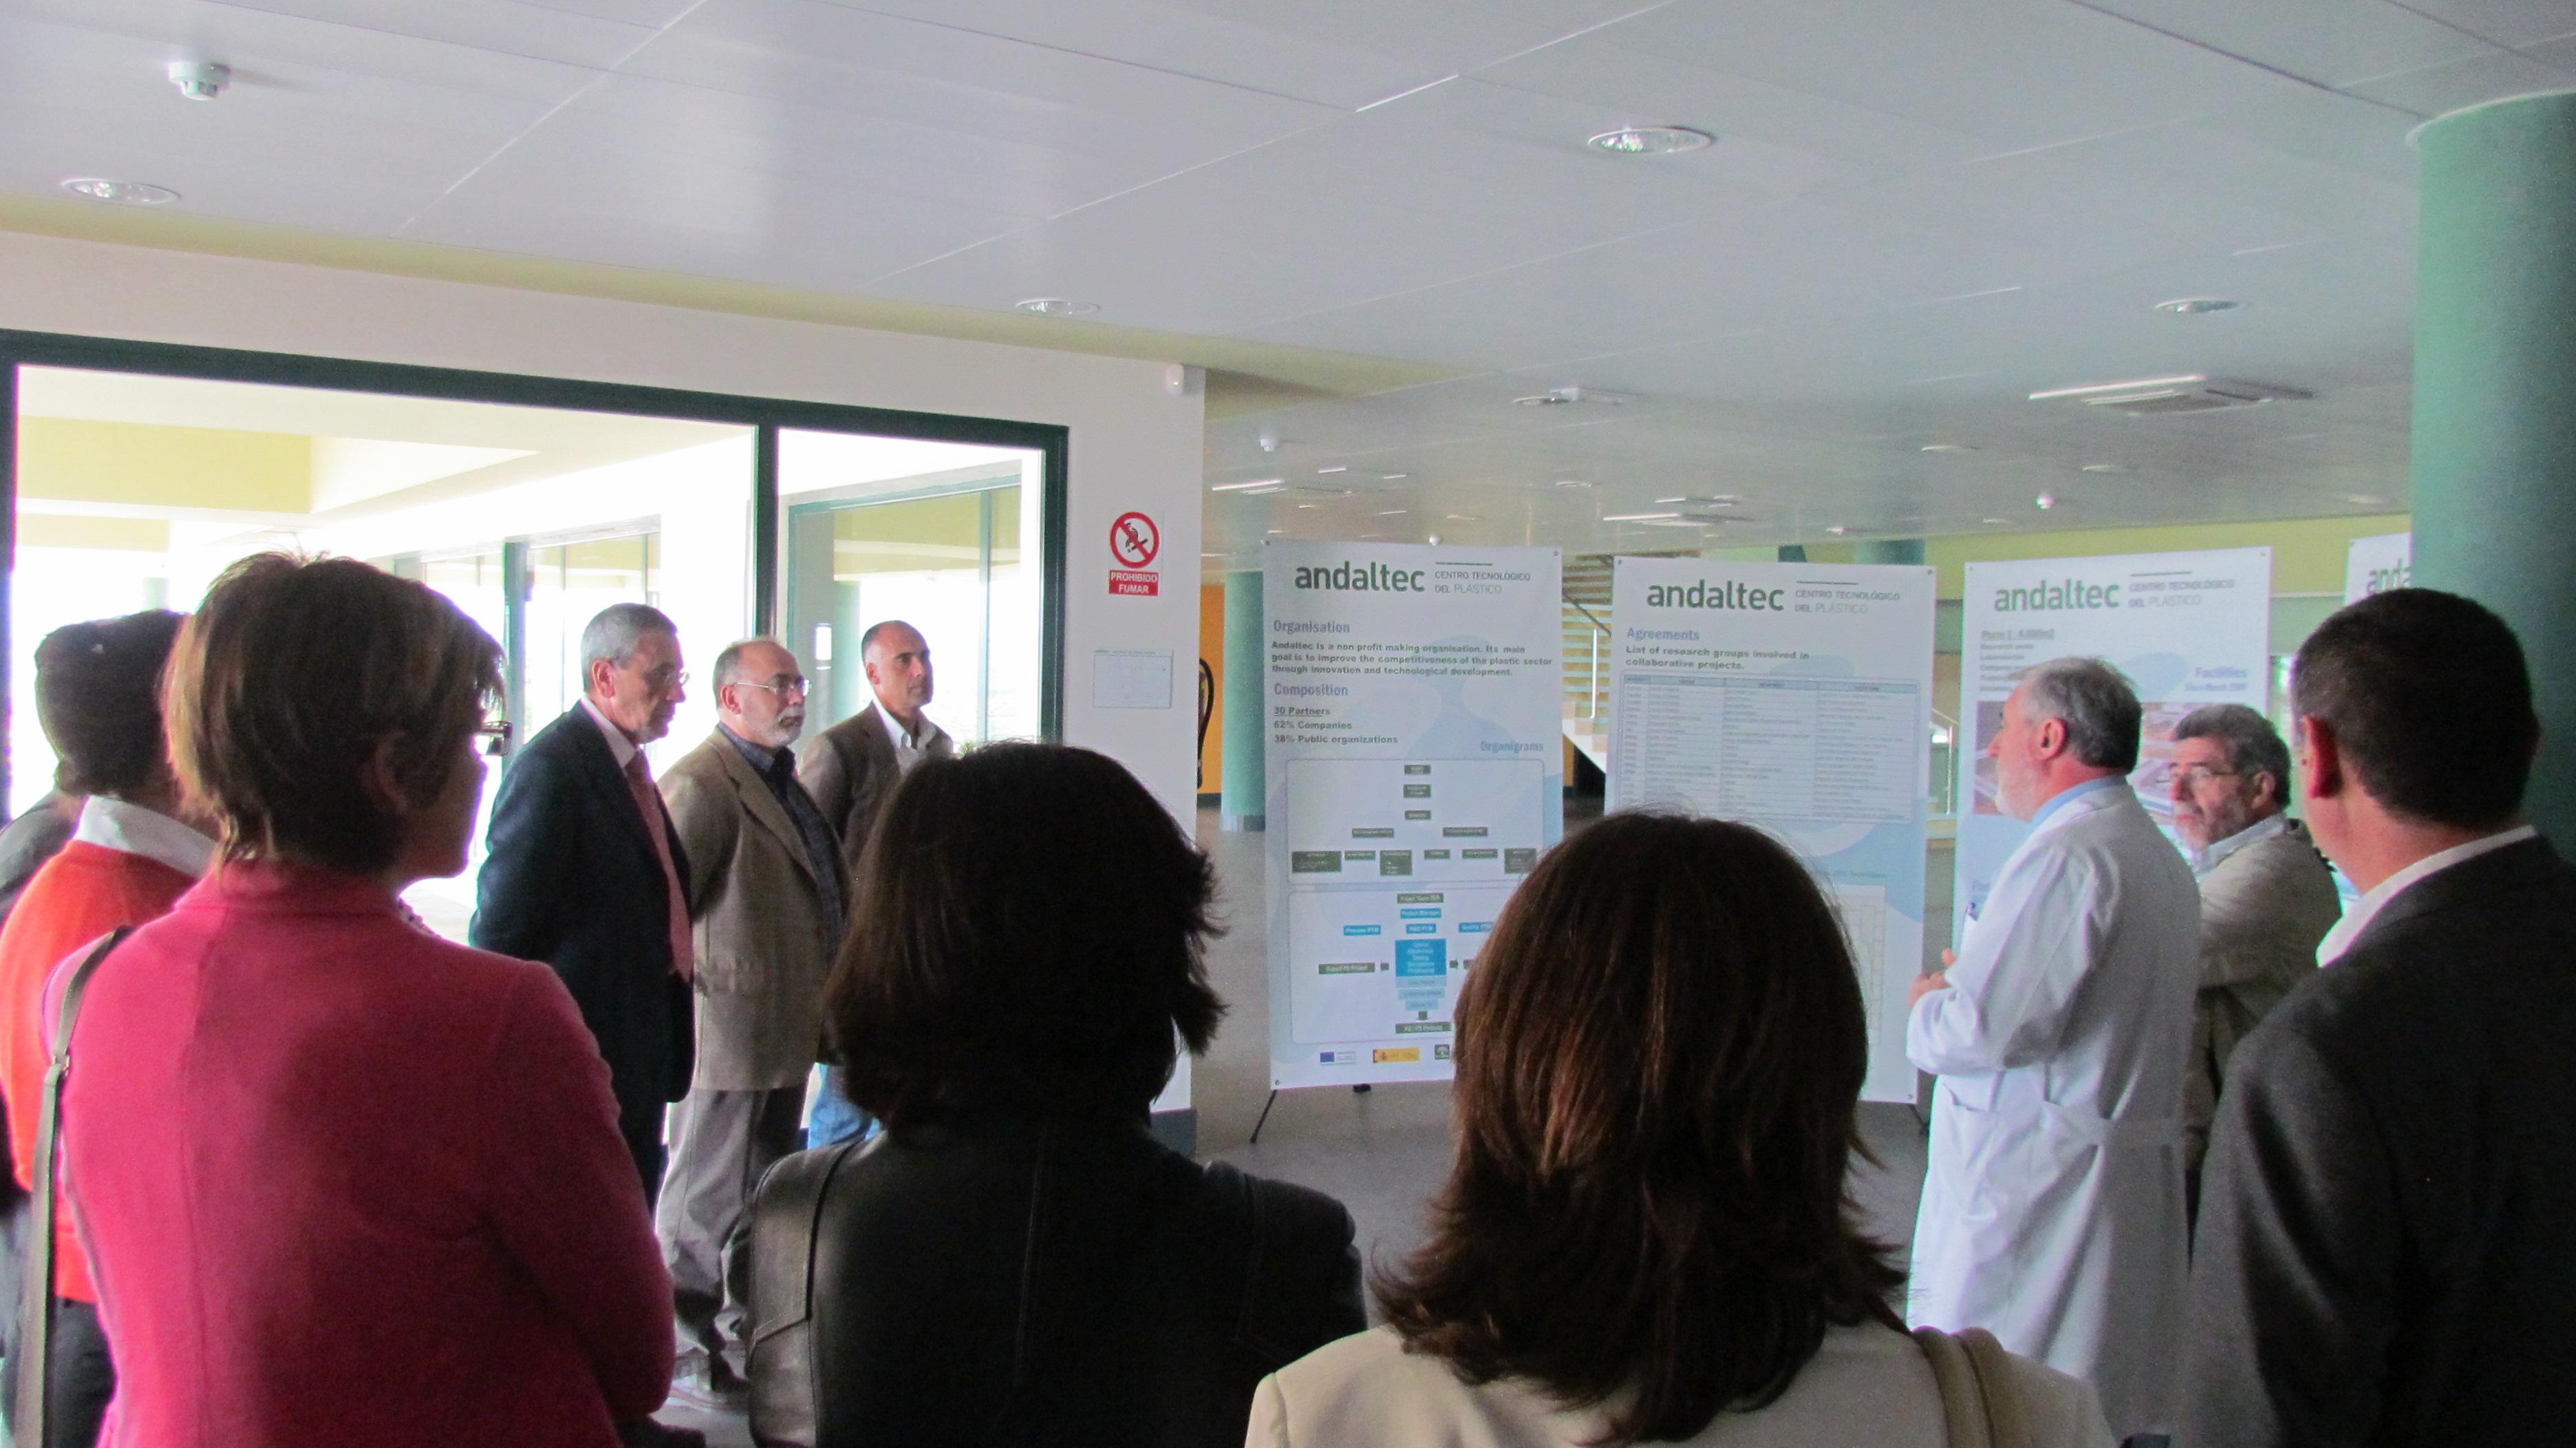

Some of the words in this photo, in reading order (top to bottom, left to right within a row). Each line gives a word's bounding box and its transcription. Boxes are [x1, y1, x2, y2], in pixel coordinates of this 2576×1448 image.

[1110, 572, 1158, 584] PROHIBIDO
[1295, 561, 1426, 593] andaltec
[1435, 571, 1469, 579] CENTRO
[1472, 571, 1531, 581] TECNOLÓGICO
[1118, 584, 1149, 594] FUMAR
[1435, 585, 1450, 593] DEL
[1454, 582, 1503, 594] PLÁSTICO
[1646, 579, 1785, 611] andaltec
[1795, 589, 1833, 599] CENTRO
[1836, 590, 1900, 601] TECNOLÓGICO
[1995, 579, 2121, 611] andaltec
[1274, 620, 1351, 634] Organisation
[1627, 627, 1700, 641] Agreements
[1271, 641, 1313, 650] Andaltec
[1316, 641, 1325, 650] is
[1357, 643, 1382, 652] profit
[1385, 643, 1419, 653] making
[1423, 645, 1483, 653] organisation.
[1486, 645, 1499, 653] Its
[1626, 646, 1646, 654] List
[1663, 648, 1710, 656] research
[1753, 650, 1796, 659] involved
[1272, 653, 1291, 662] goal
[1318, 654, 1356, 663] improve
[1378, 655, 1457, 665] competitiveness
[1460, 656, 1469, 664] of
[1490, 657, 1520, 666] plastic
[1626, 658, 1694, 668] collaborative
[1697, 661, 1745, 670] projects.
[1272, 665, 1308, 675] through
[1364, 666, 1381, 674] and
[1384, 667, 1448, 677] technological
[1450, 668, 1513, 677] development.
[1274, 683, 1348, 697] Composition
[1274, 707, 1285, 715] 30
[1289, 707, 1331, 715] Partners
[1274, 721, 1294, 729] 62%
[1298, 721, 1353, 730] Companies
[1274, 734, 1295, 743] 38%
[1298, 735, 1328, 743] Public
[1331, 736, 1398, 745] organizations
[1480, 741, 1544, 754] Organigrams
